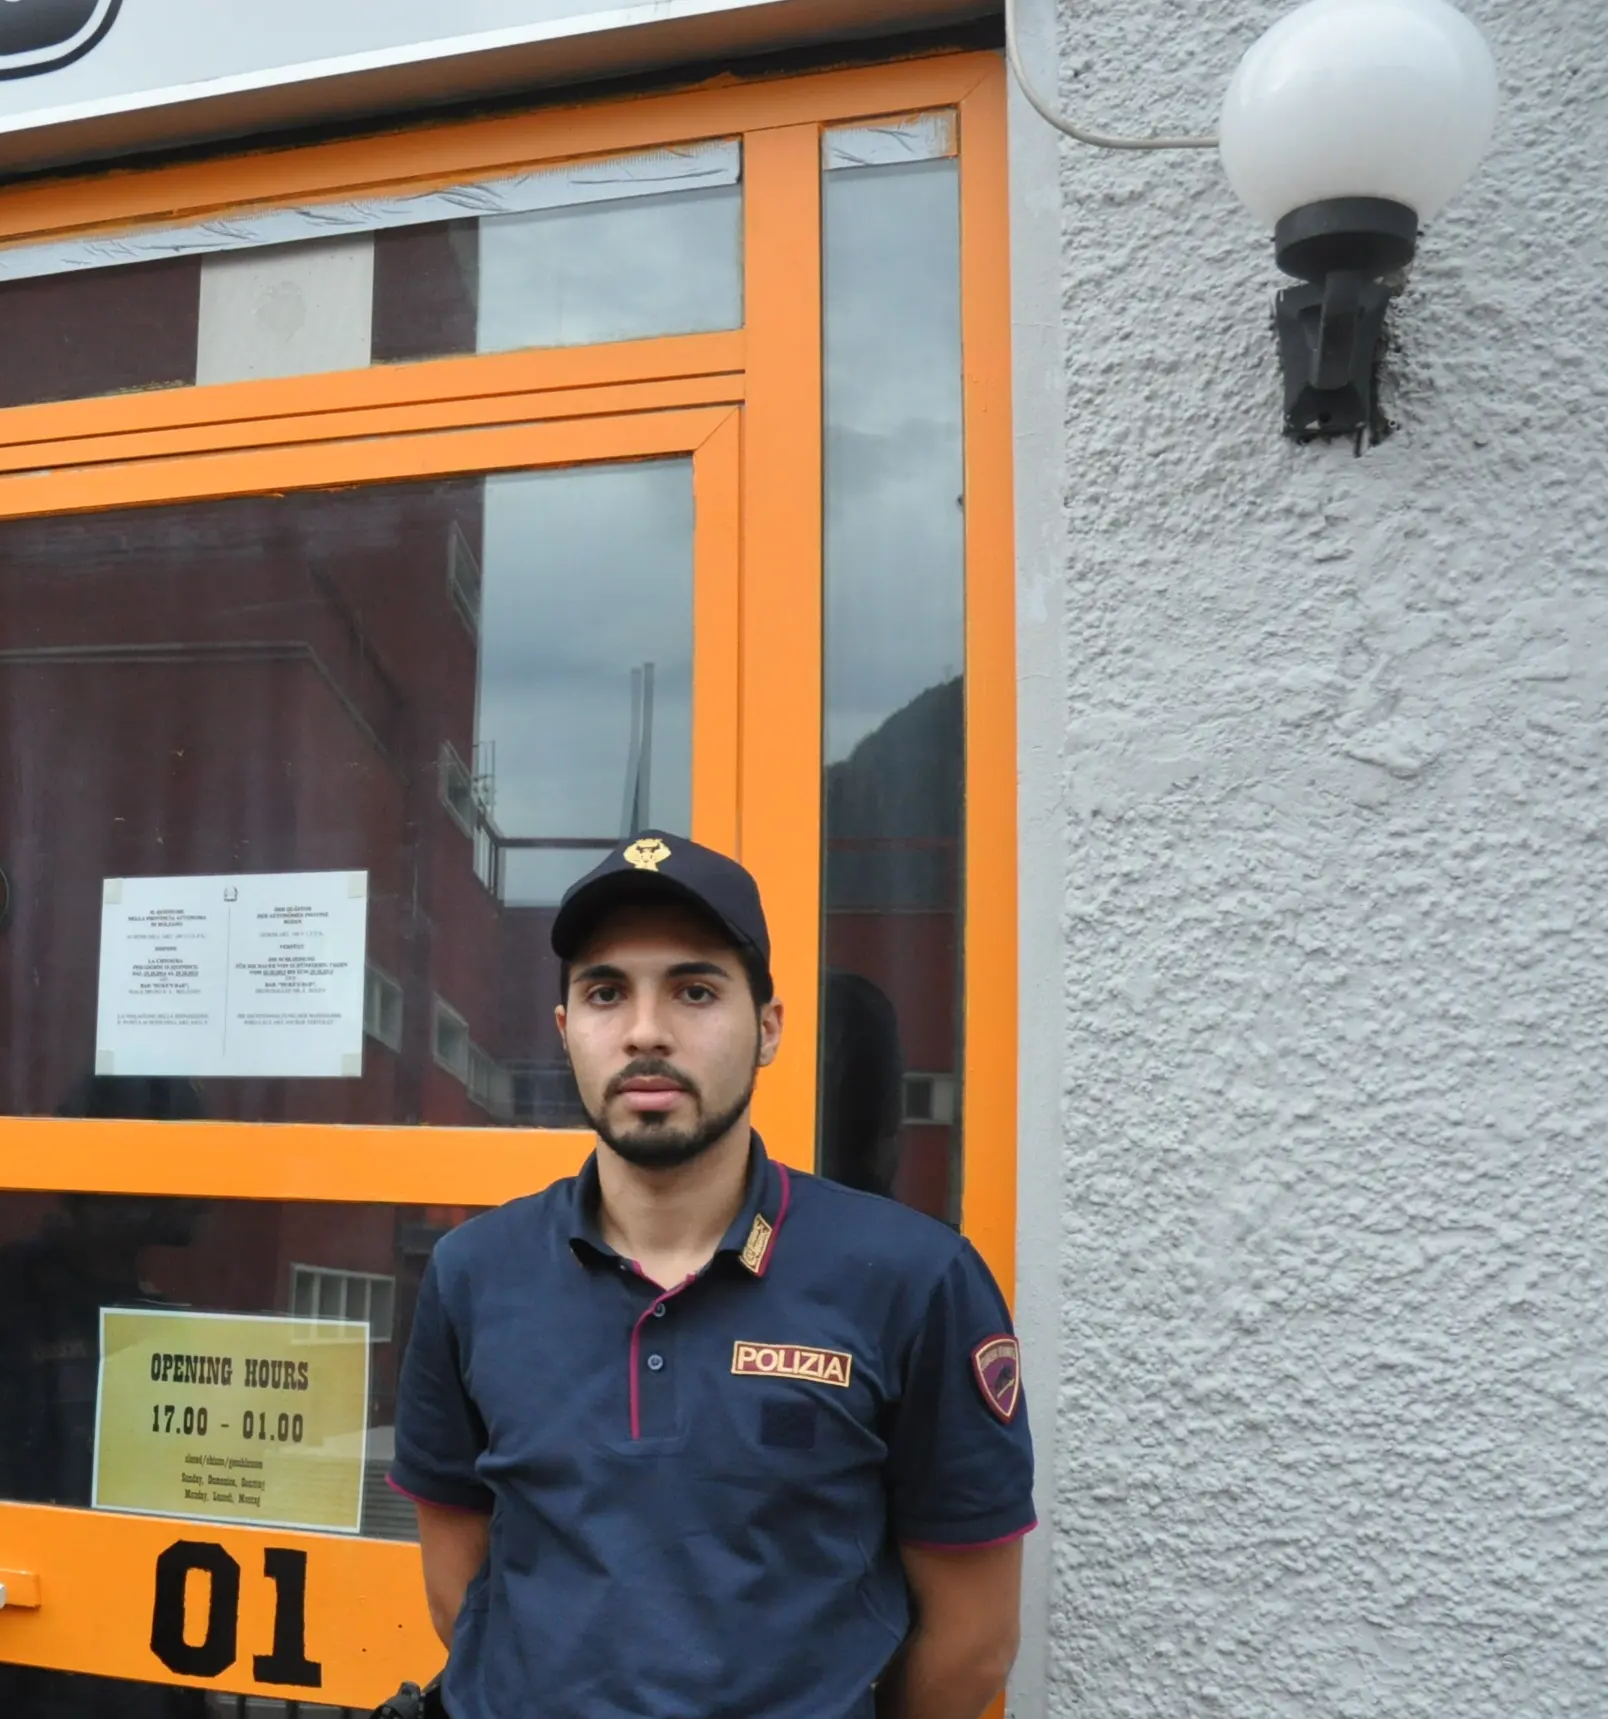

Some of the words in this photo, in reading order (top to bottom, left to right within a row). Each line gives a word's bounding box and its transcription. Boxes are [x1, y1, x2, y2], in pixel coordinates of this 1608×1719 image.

[151, 1353, 233, 1386] OPENING
[244, 1358, 309, 1391] HOURS
[737, 1346, 846, 1381] POLIZIA
[152, 1405, 208, 1436] 17.00
[243, 1410, 304, 1443] 01.00
[149, 1539, 322, 1688] 01
